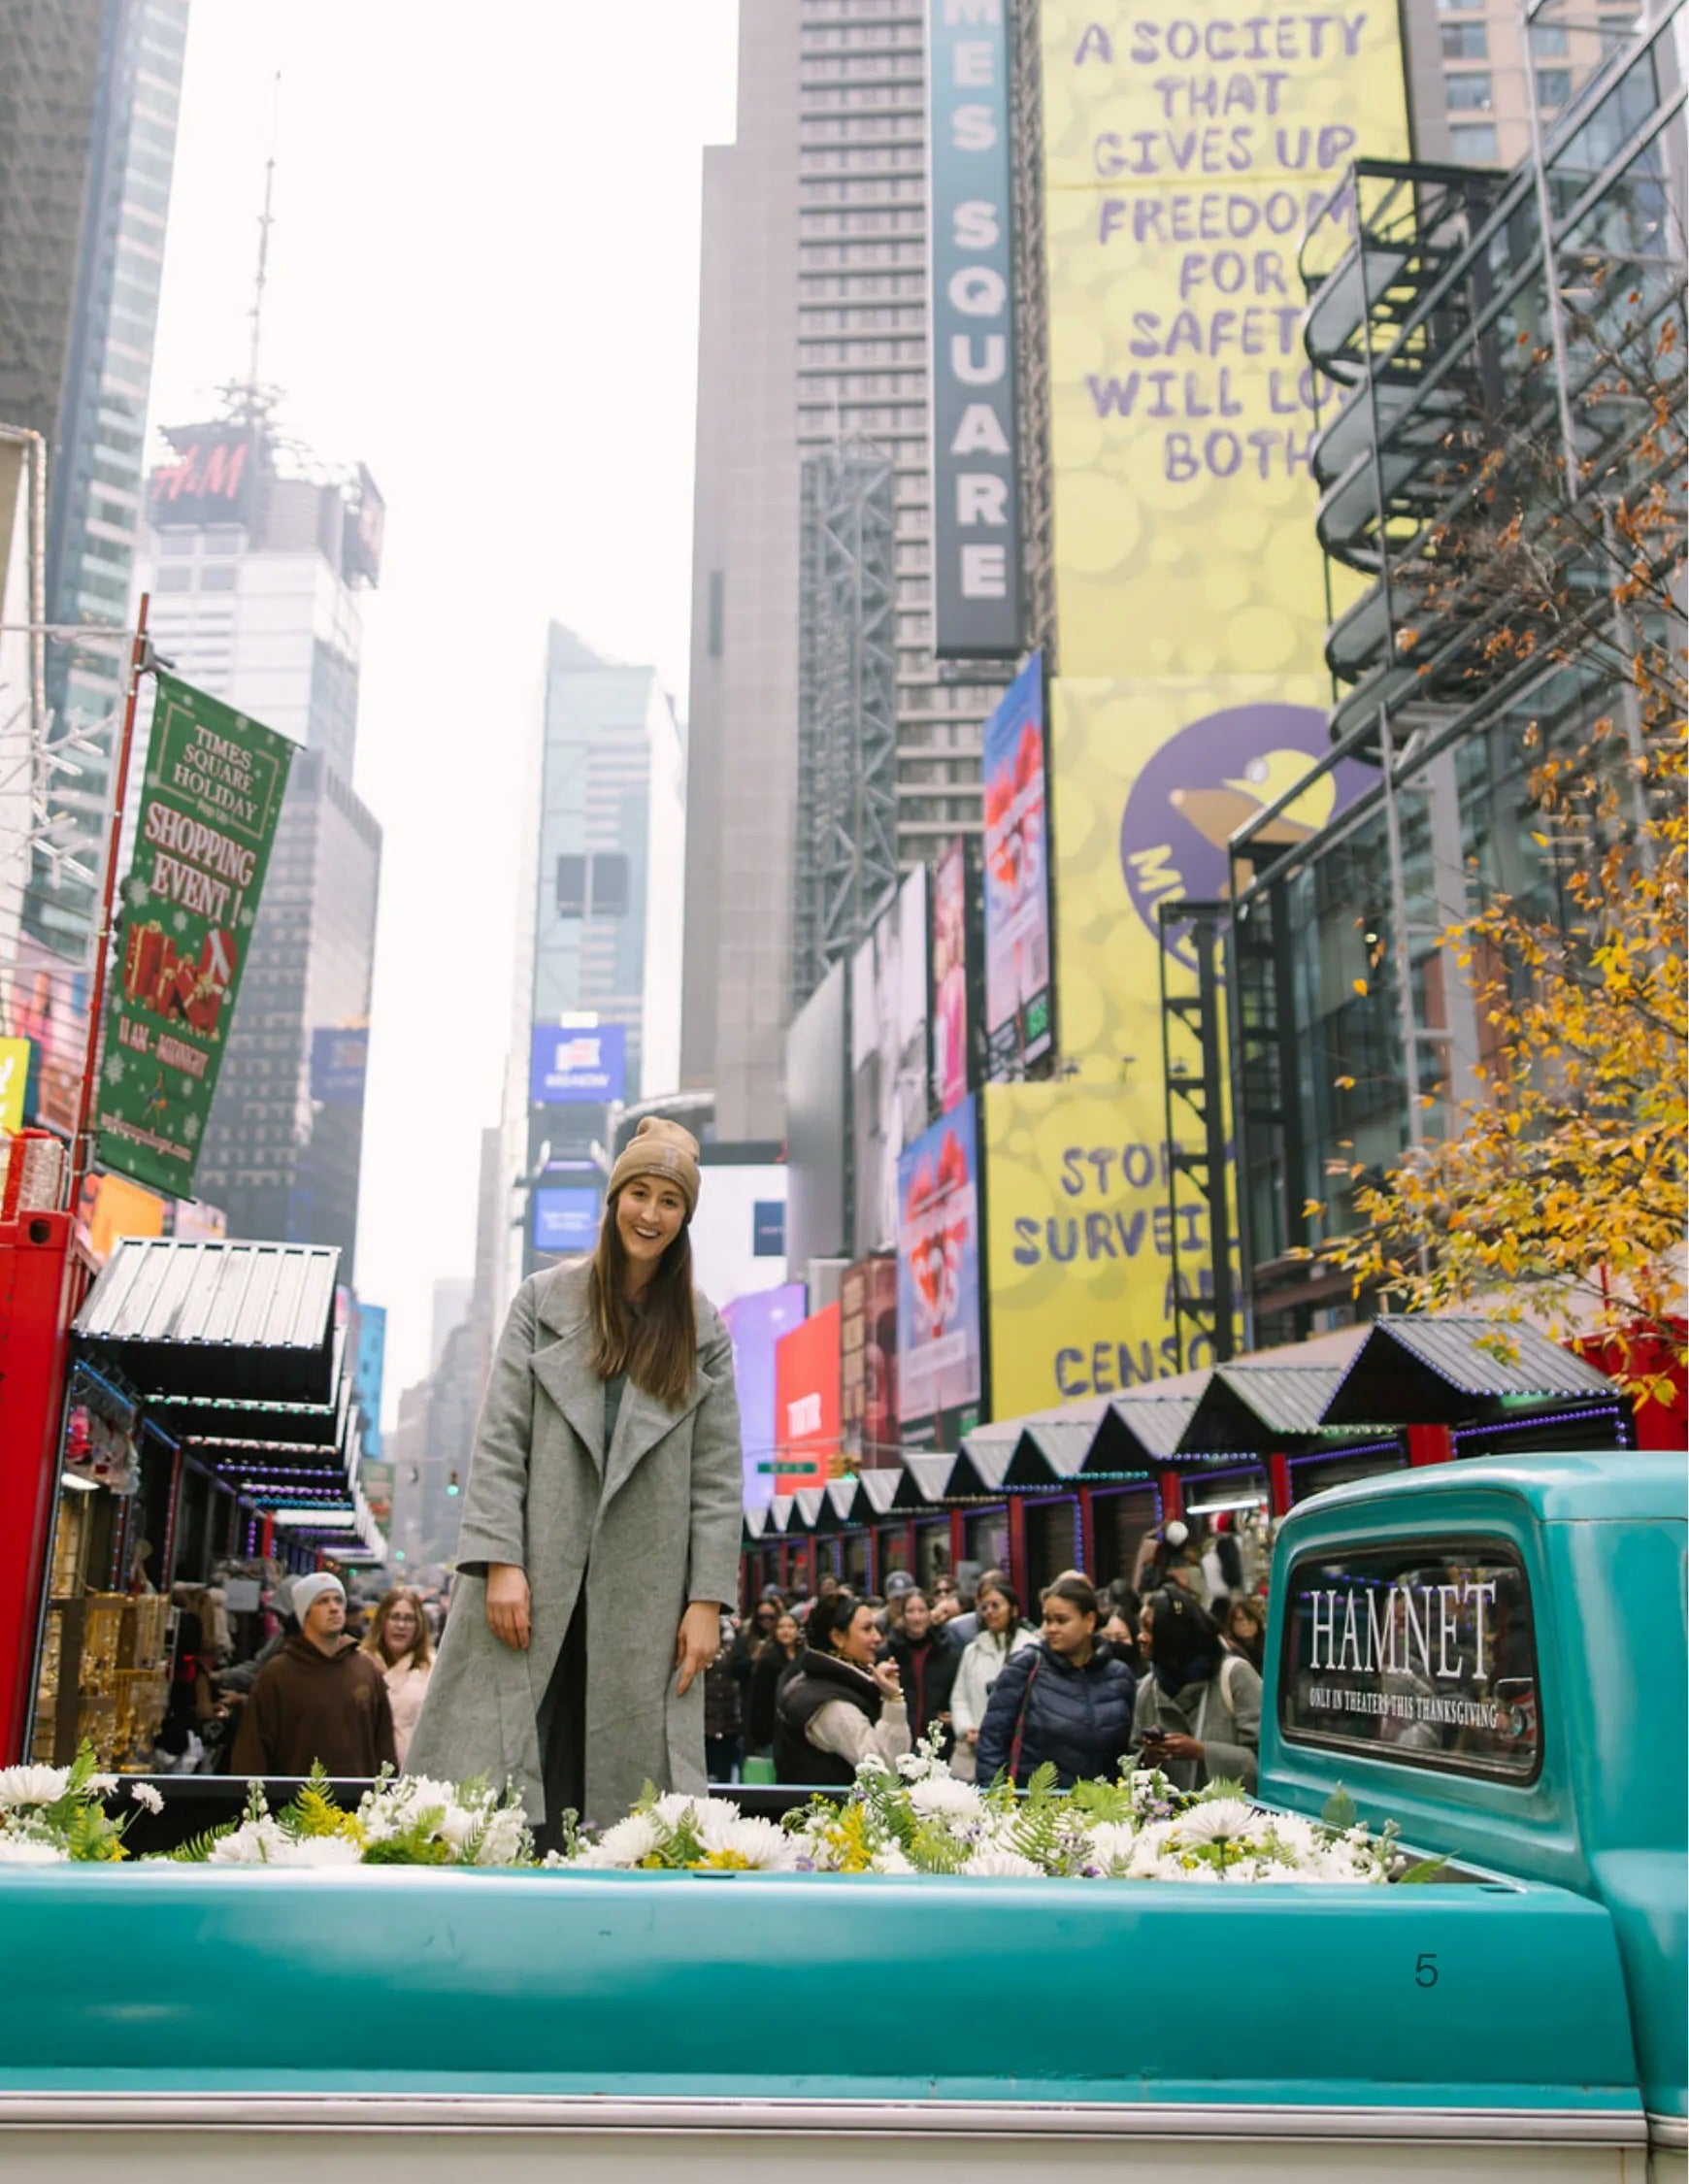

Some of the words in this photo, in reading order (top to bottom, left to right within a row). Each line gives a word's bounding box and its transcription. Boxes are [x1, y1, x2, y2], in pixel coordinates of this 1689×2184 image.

[1075, 23, 1112, 65] A
[1131, 14, 1368, 64] SOCIETY
[1153, 72, 1289, 118] THAT
[1094, 124, 1254, 177] GIVES
[1275, 125, 1357, 170] UP
[1099, 181, 1358, 245] FREEDOM
[1179, 249, 1287, 300] FOR
[1129, 308, 1305, 357] SAFET
[947, 200, 1010, 599] SQUARE
[1085, 367, 1242, 418] WILL
[1269, 367, 1348, 415] LO
[1165, 428, 1317, 482] BOTH
[182, 744, 254, 795] SQUARE
[194, 724, 253, 770] TIMES
[173, 762, 259, 822] HOLIDAY
[146, 800, 256, 887] SHOPPING
[1012, 1204, 1239, 1266] SURVEI
[1055, 1333, 1219, 1398] CENSO
[1310, 1579, 1497, 1680] HAMNET
[1390, 1695, 1414, 1719] THIS
